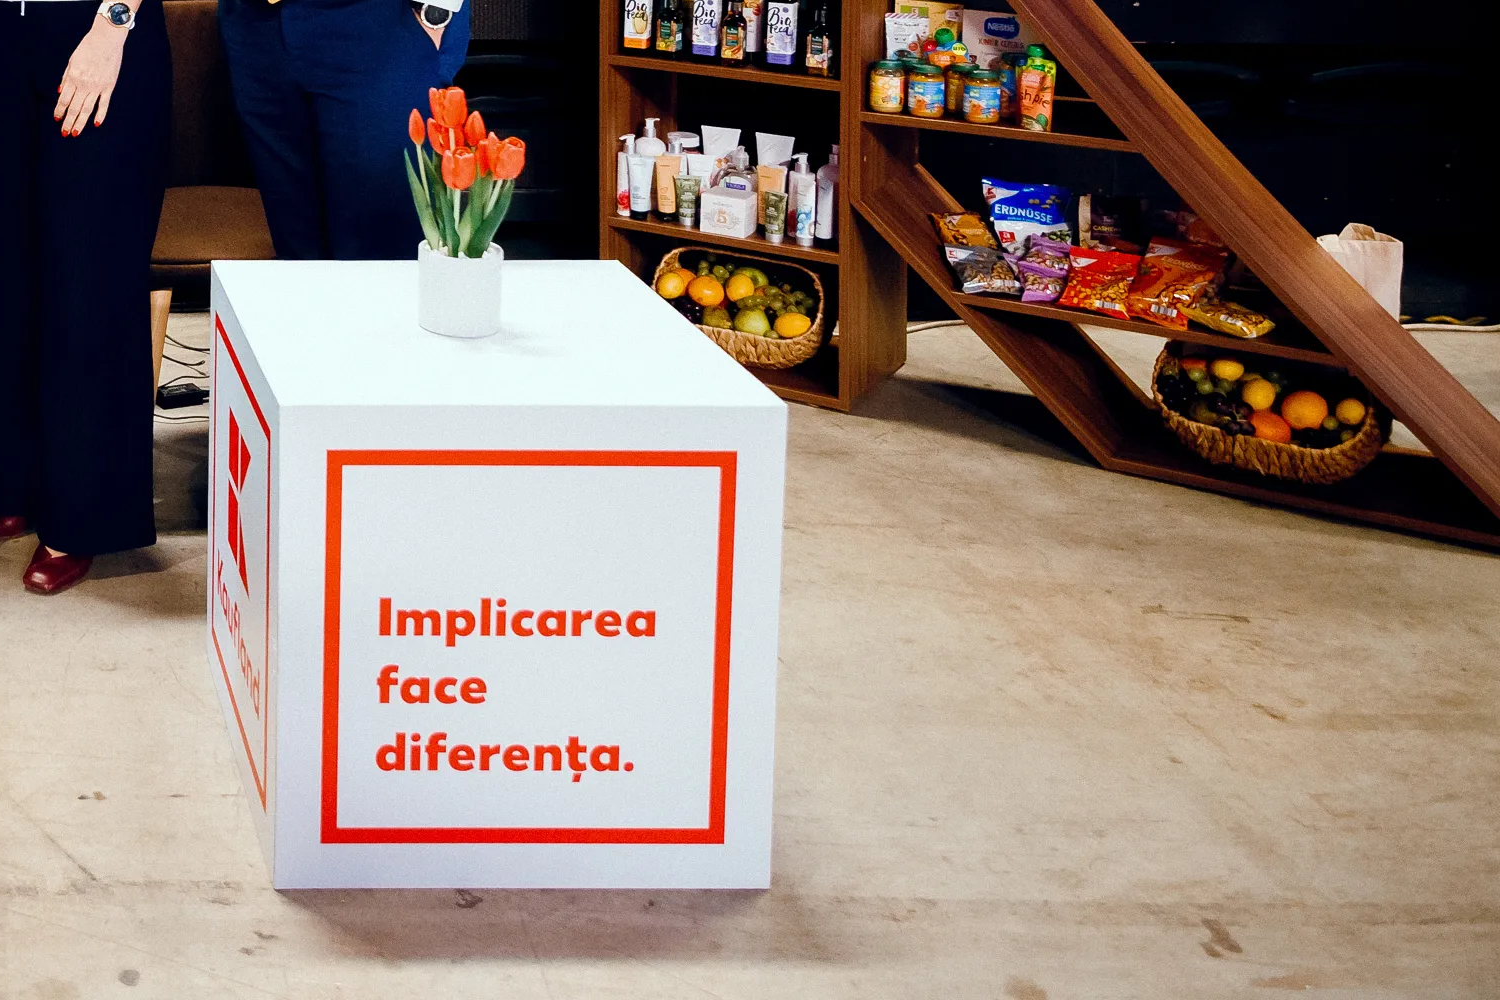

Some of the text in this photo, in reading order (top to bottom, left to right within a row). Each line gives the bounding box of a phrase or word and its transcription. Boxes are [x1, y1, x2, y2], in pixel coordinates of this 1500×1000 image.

[994, 202, 1053, 224] ERDNÜSSE
[217, 548, 260, 721] Kaufland
[377, 596, 657, 647] Implicarea
[376, 663, 488, 705] face
[375, 731, 635, 783] diferența.
